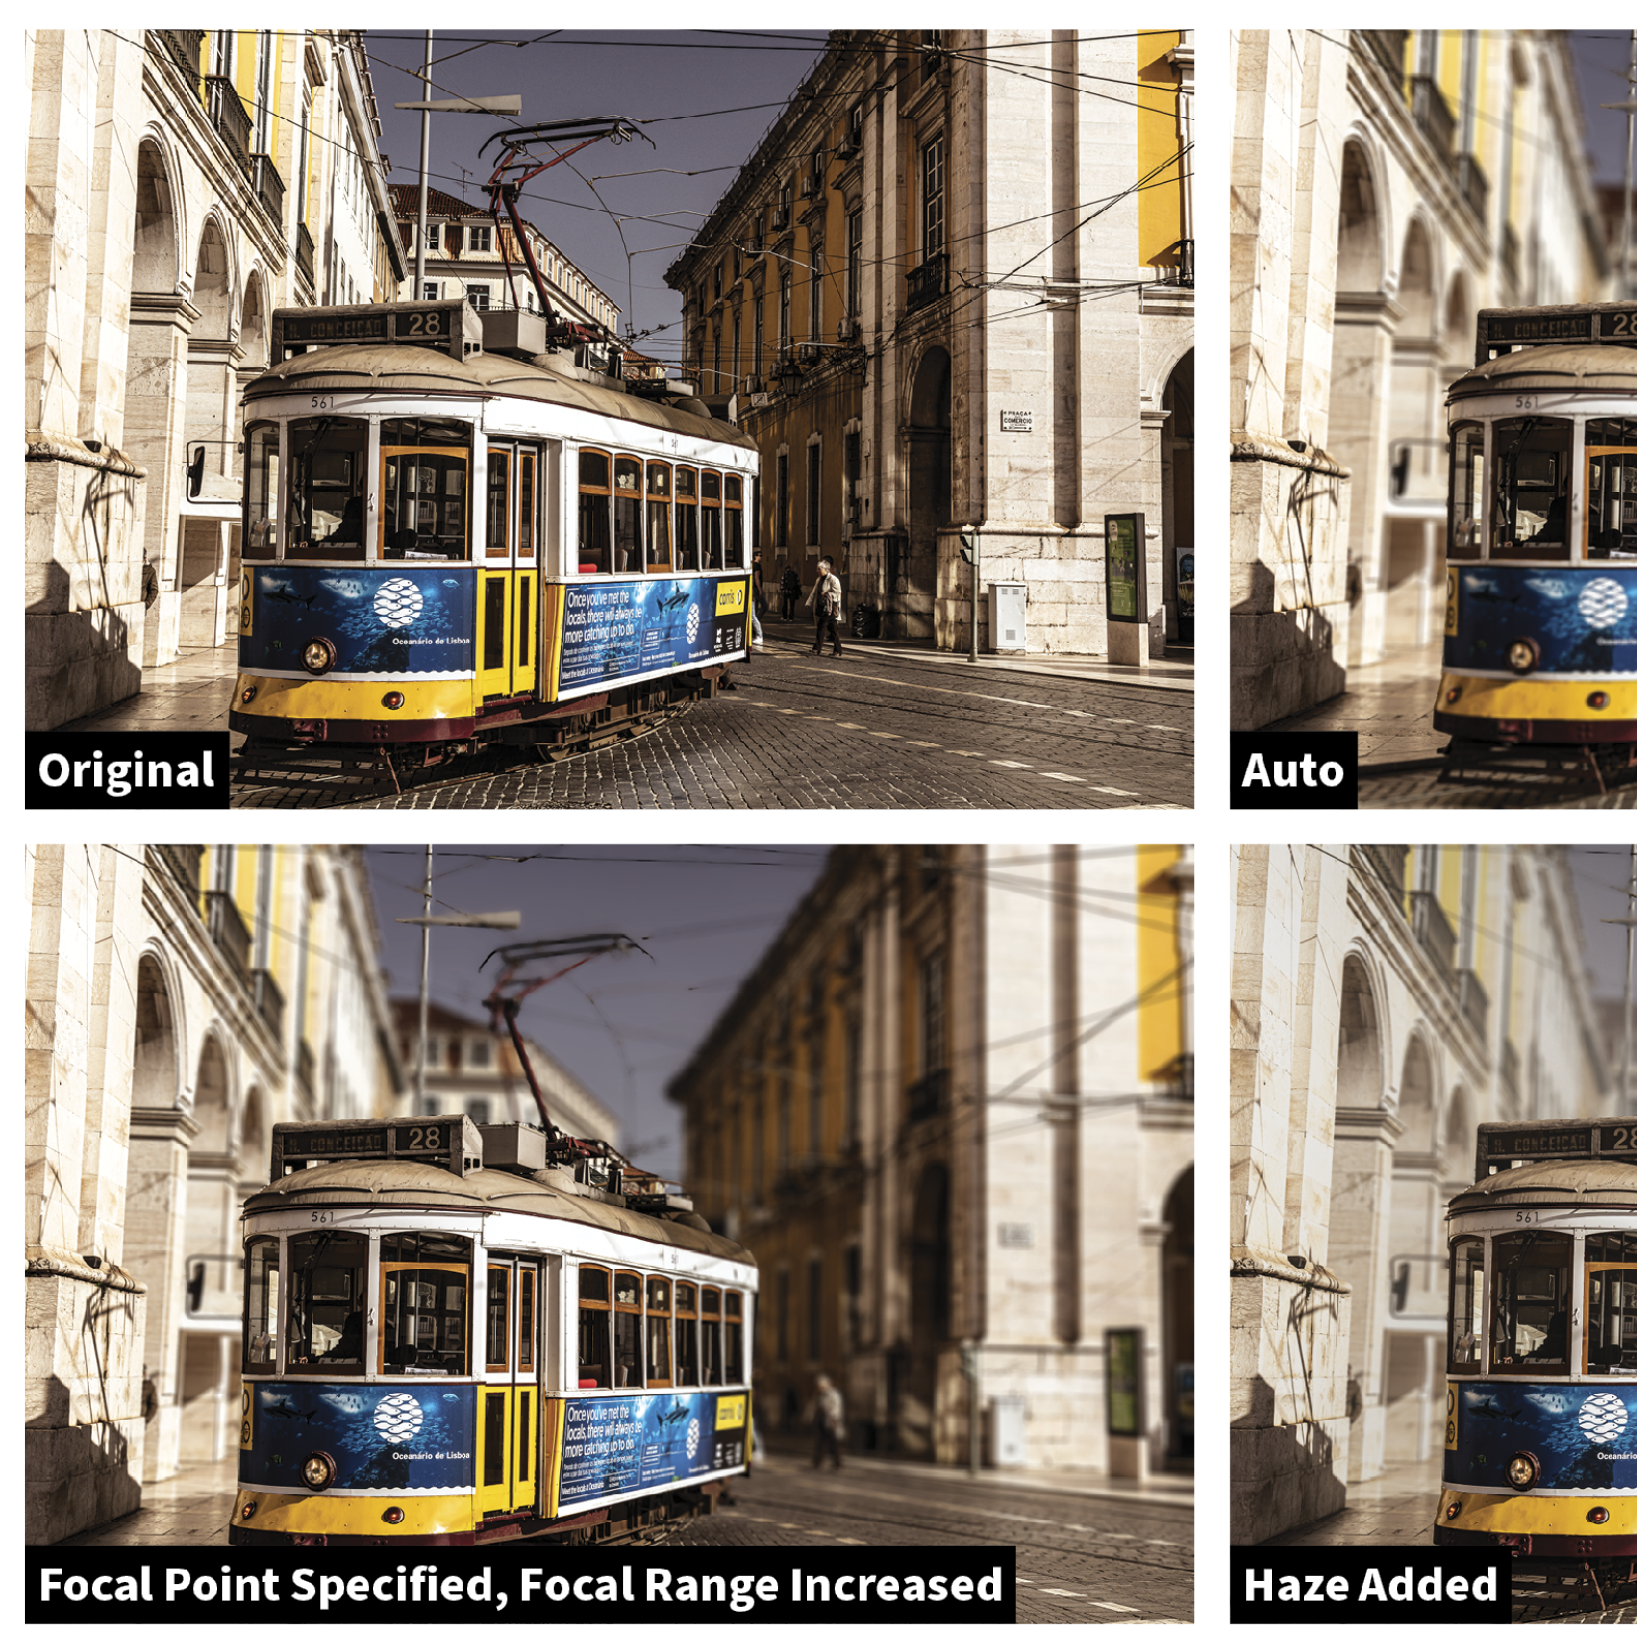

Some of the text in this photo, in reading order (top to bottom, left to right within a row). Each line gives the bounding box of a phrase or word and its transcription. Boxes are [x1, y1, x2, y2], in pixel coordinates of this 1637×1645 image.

[409, 312, 441, 335] 28
[311, 396, 334, 409] 561
[1516, 396, 1539, 409] 561
[567, 592, 586, 608] Once
[608, 591, 619, 604] met
[620, 590, 630, 603] the
[566, 605, 642, 626] locals, there will always be
[392, 636, 470, 645] Oceanário de Lisboa
[564, 629, 584, 644] more
[584, 624, 610, 642] catching
[610, 625, 618, 640] up
[618, 623, 625, 636] to
[409, 1126, 441, 1149] 28
[311, 1210, 334, 1223] 561
[1516, 1210, 1539, 1223] 561
[567, 1406, 586, 1422] Once
[608, 1405, 619, 1418] met
[620, 1404, 630, 1417] the
[566, 1419, 642, 1440] locals, there will always be
[392, 1452, 470, 1460] Oceanário de Lisboa
[564, 1443, 584, 1458] more
[584, 1438, 610, 1456] catching
[610, 1439, 618, 1454] up
[618, 1437, 625, 1450] to
[1597, 1452, 1637, 1460] Oceanário
